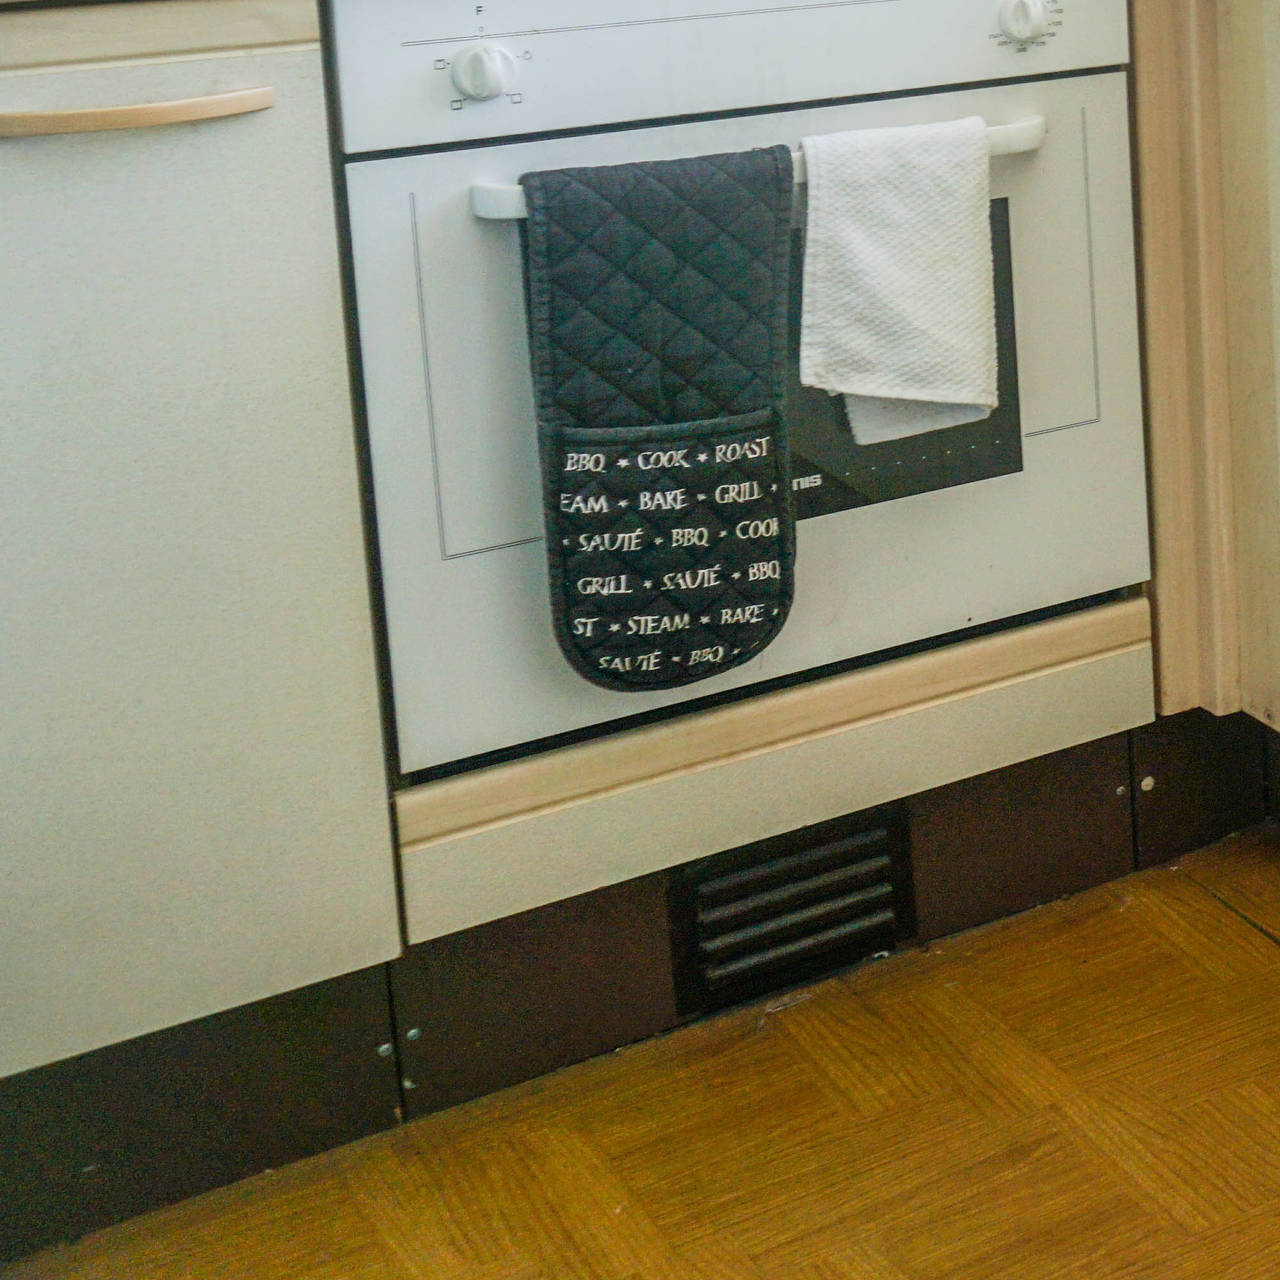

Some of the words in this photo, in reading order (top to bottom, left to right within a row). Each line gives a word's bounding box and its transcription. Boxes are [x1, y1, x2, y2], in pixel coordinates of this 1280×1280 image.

[564, 453, 606, 472] BBQ
[638, 449, 691, 470] COOK
[715, 437, 771, 463] ROAST
[560, 494, 609, 514] EAM
[639, 489, 688, 511] BAKE
[715, 481, 762, 504] GRILL
[577, 528, 644, 552] SAUTÉ
[671, 528, 709, 547] BBQ
[577, 574, 633, 596] GRILL
[660, 564, 722, 591] SAUTÉ
[748, 560, 781, 581] BBQ
[573, 618, 599, 636] ST
[626, 613, 690, 635] STEAM
[721, 604, 765, 623] BAKE
[689, 645, 724, 666] BBQ
